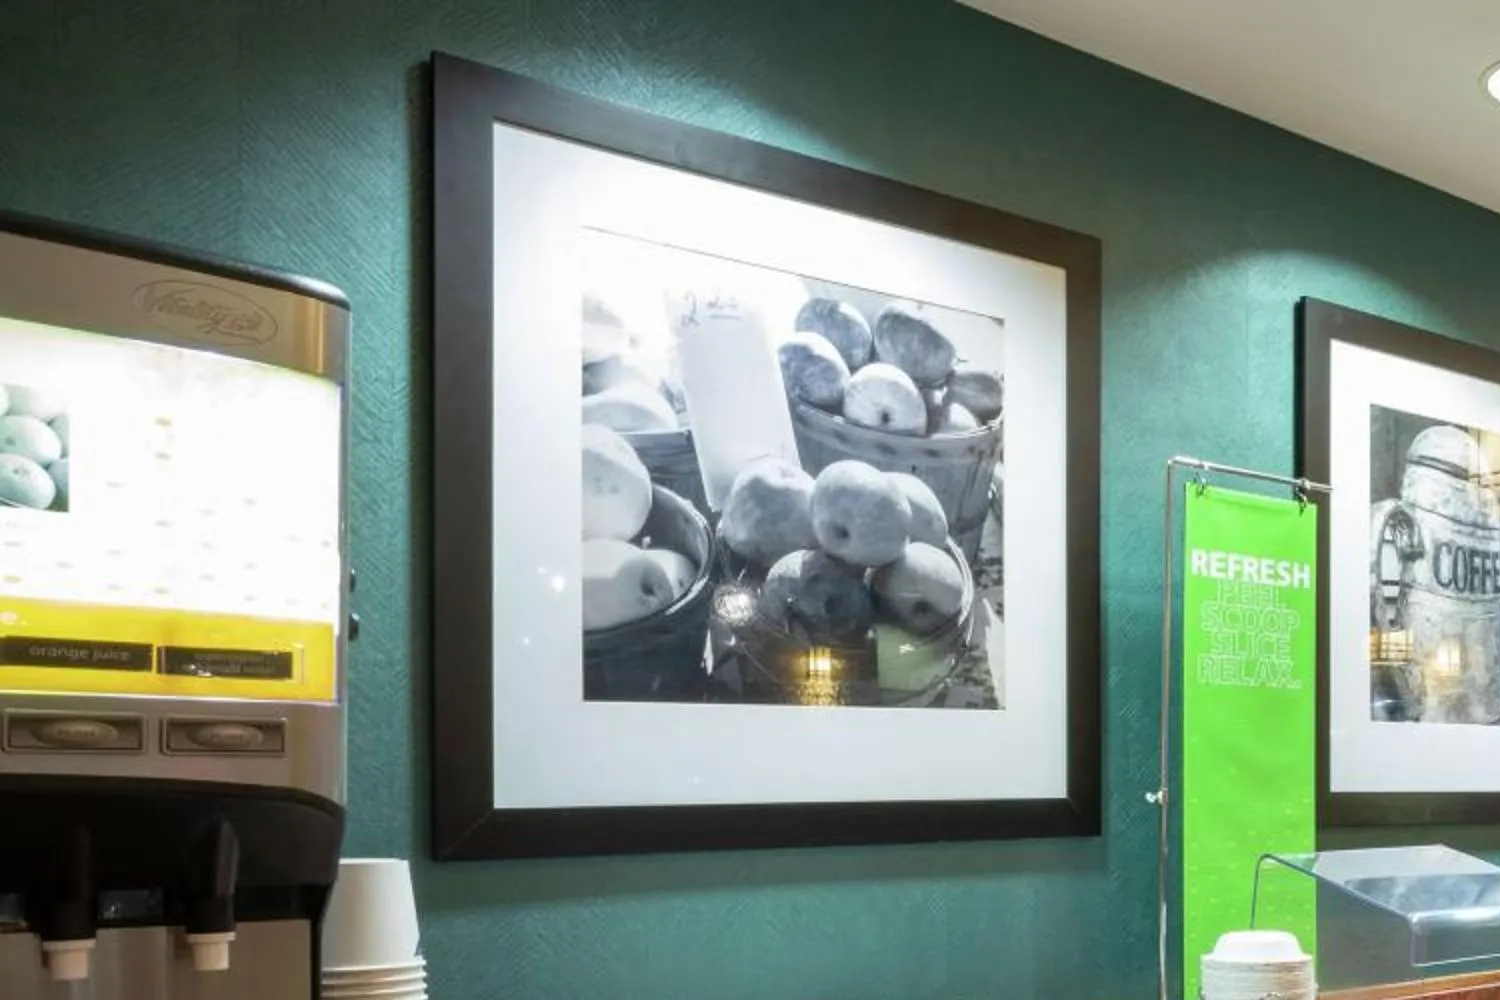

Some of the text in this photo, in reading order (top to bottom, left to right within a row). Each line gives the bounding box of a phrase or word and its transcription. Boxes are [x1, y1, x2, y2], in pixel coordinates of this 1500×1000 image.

[1191, 548, 1311, 589] REFRESH
[1200, 599, 1300, 635] SCOOP
[28, 645, 132, 662] orange juice
[1211, 629, 1291, 663] SLICE
